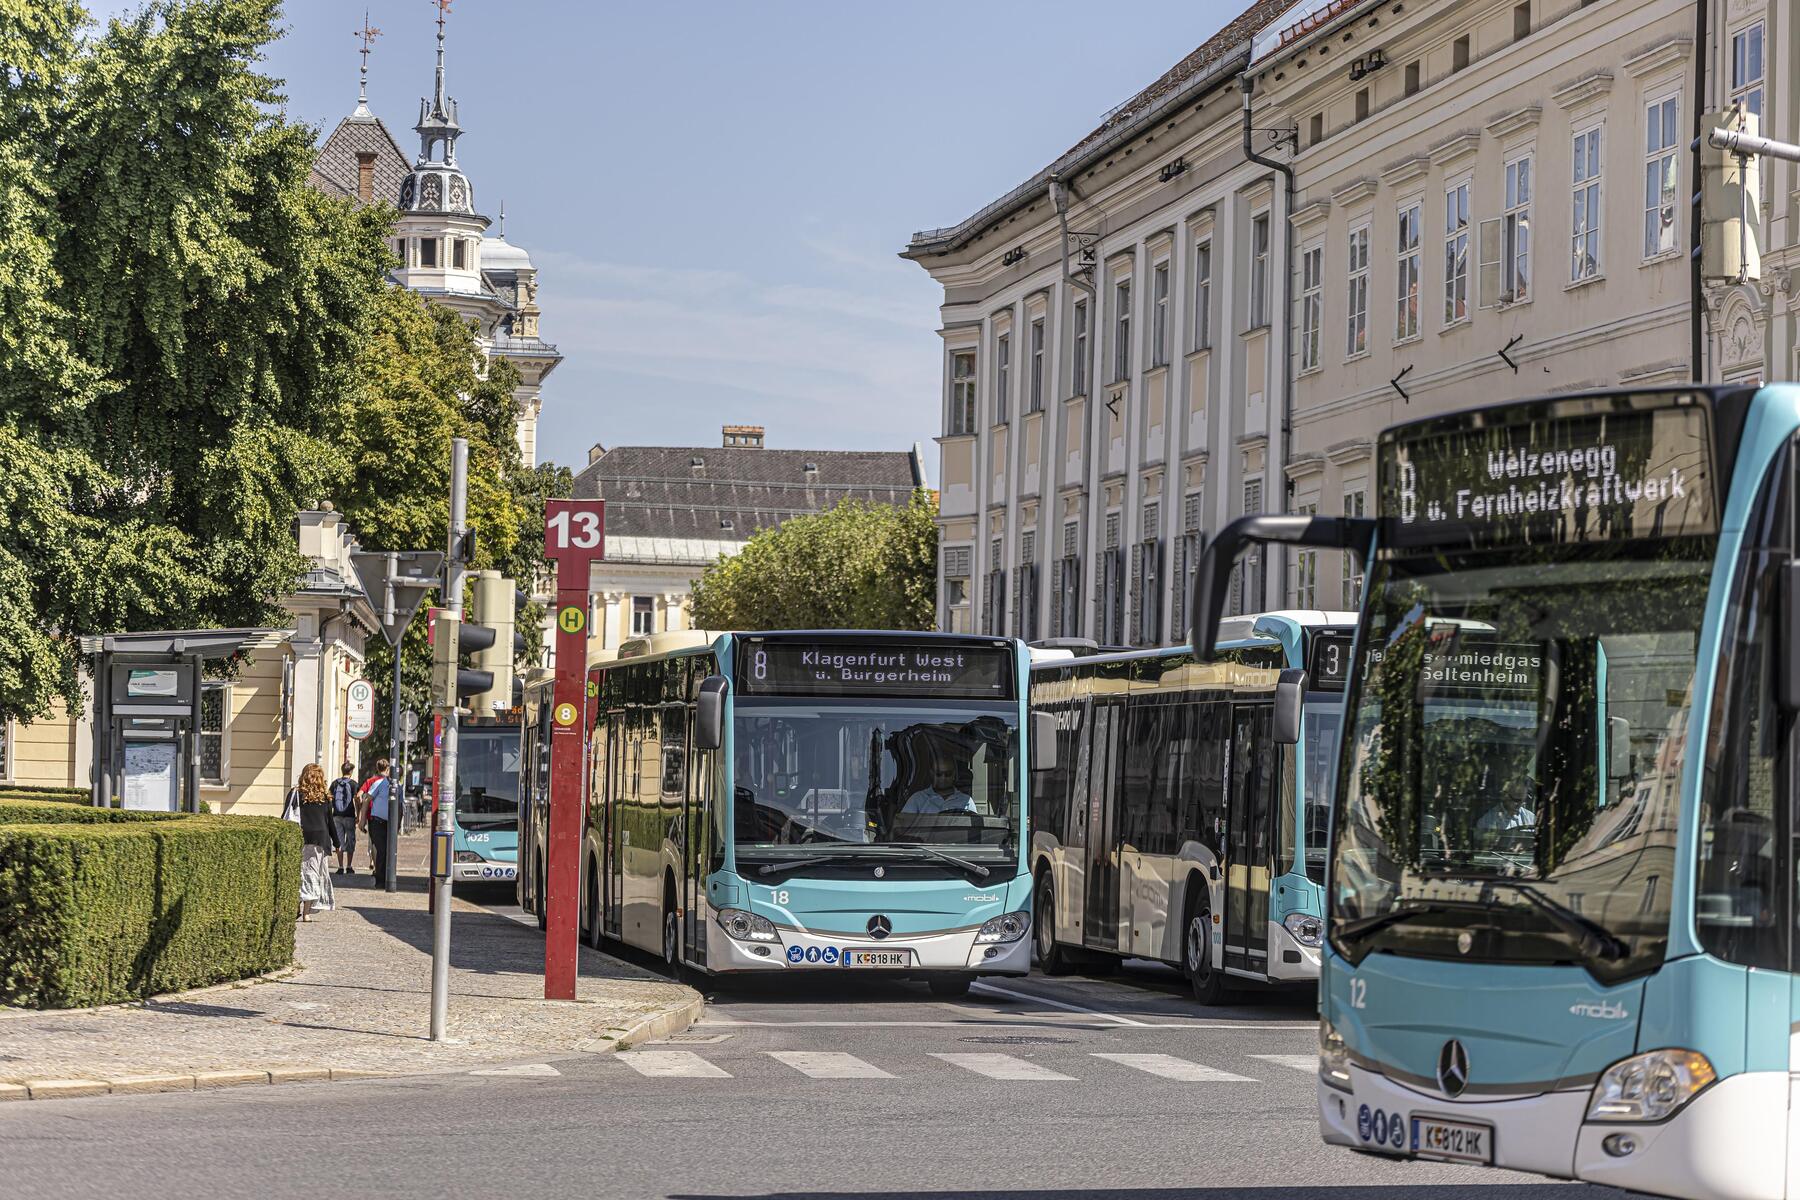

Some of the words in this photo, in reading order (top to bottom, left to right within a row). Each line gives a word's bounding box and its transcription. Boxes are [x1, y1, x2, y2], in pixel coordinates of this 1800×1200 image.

[1487, 444, 1617, 480] Welzenegg
[1456, 467, 1685, 522] Fernheizkraftwerk
[547, 511, 601, 549] 13
[754, 650, 767, 680] 8
[801, 651, 907, 669] Klagenfurt
[916, 654, 965, 668] West
[1326, 644, 1339, 675] 3
[1423, 651, 1541, 671] smiedgas
[561, 707, 571, 720] 8
[770, 890, 790, 905] 18
[890, 953, 903, 964] HK
[1350, 978, 1366, 1009] 12
[1575, 999, 1622, 1019] mobil
